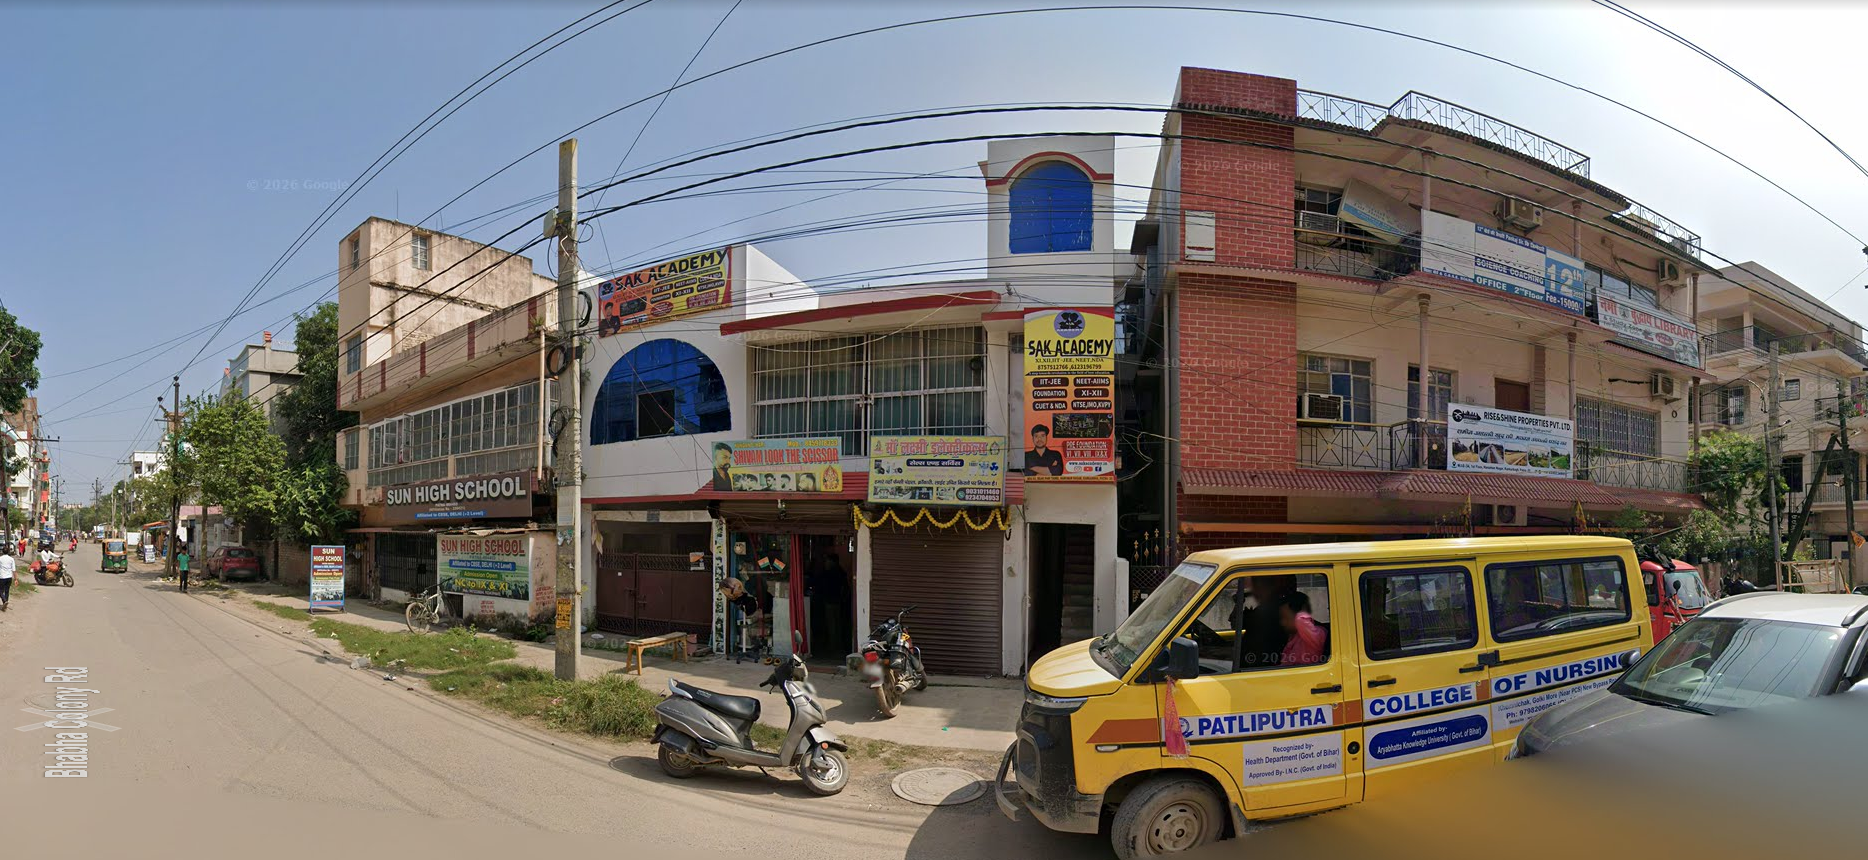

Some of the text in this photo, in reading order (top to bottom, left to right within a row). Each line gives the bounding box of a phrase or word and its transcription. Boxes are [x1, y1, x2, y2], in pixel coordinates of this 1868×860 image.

[615, 270, 644, 291] SAK
[646, 248, 728, 282] ACADEMY
[1476, 258, 1544, 285] SCIENCE COACHING
[1476, 276, 1507, 291] OFFICE
[1524, 290, 1543, 301] Floor
[1654, 318, 1695, 340] LIBRARY
[1028, 340, 1114, 357] SAK ACADEMY
[1500, 413, 1517, 424] SHINE
[1517, 415, 1549, 428] PROPERTIES
[1549, 420, 1561, 429] PVT.
[1561, 421, 1572, 431] LTD.
[733, 450, 763, 465] SHIVAM
[785, 448, 801, 464] THE
[801, 447, 839, 464] SCISSOR
[387, 476, 526, 505] SUN HIGH SCHOOL
[441, 540, 526, 556] SUN HIGH SCHOOL
[455, 579, 466, 588] NC
[489, 581, 496, 589] &
[499, 582, 509, 591] XI
[1369, 684, 1473, 717] COLLEGE
[1494, 674, 1527, 694] OF
[1545, 693, 1558, 701] More
[1582, 684, 1593, 692] New
[1593, 680, 1609, 690] Bypass
[1198, 707, 1327, 736] PATLIPUTRA
[1506, 711, 1518, 719] Ph:
[1377, 743, 1402, 755] Aryabhatta
[1402, 738, 1428, 750] Knowledge
[1427, 734, 1449, 744] University
[1452, 731, 1464, 740] Govt.
[1464, 729, 1469, 737] of
[1469, 726, 1482, 736] Bihar)
[1411, 727, 1438, 737] Affiliated
[1245, 748, 1340, 766] Health Department (Govt. of Bihar)
[1272, 743, 1314, 754] Recognized by-
[1248, 770, 1275, 779] Approved
[1275, 769, 1285, 778] By-
[1300, 765, 1316, 775] (Govt.
[1316, 764, 1323, 772] of
[1323, 762, 1337, 771] India)
